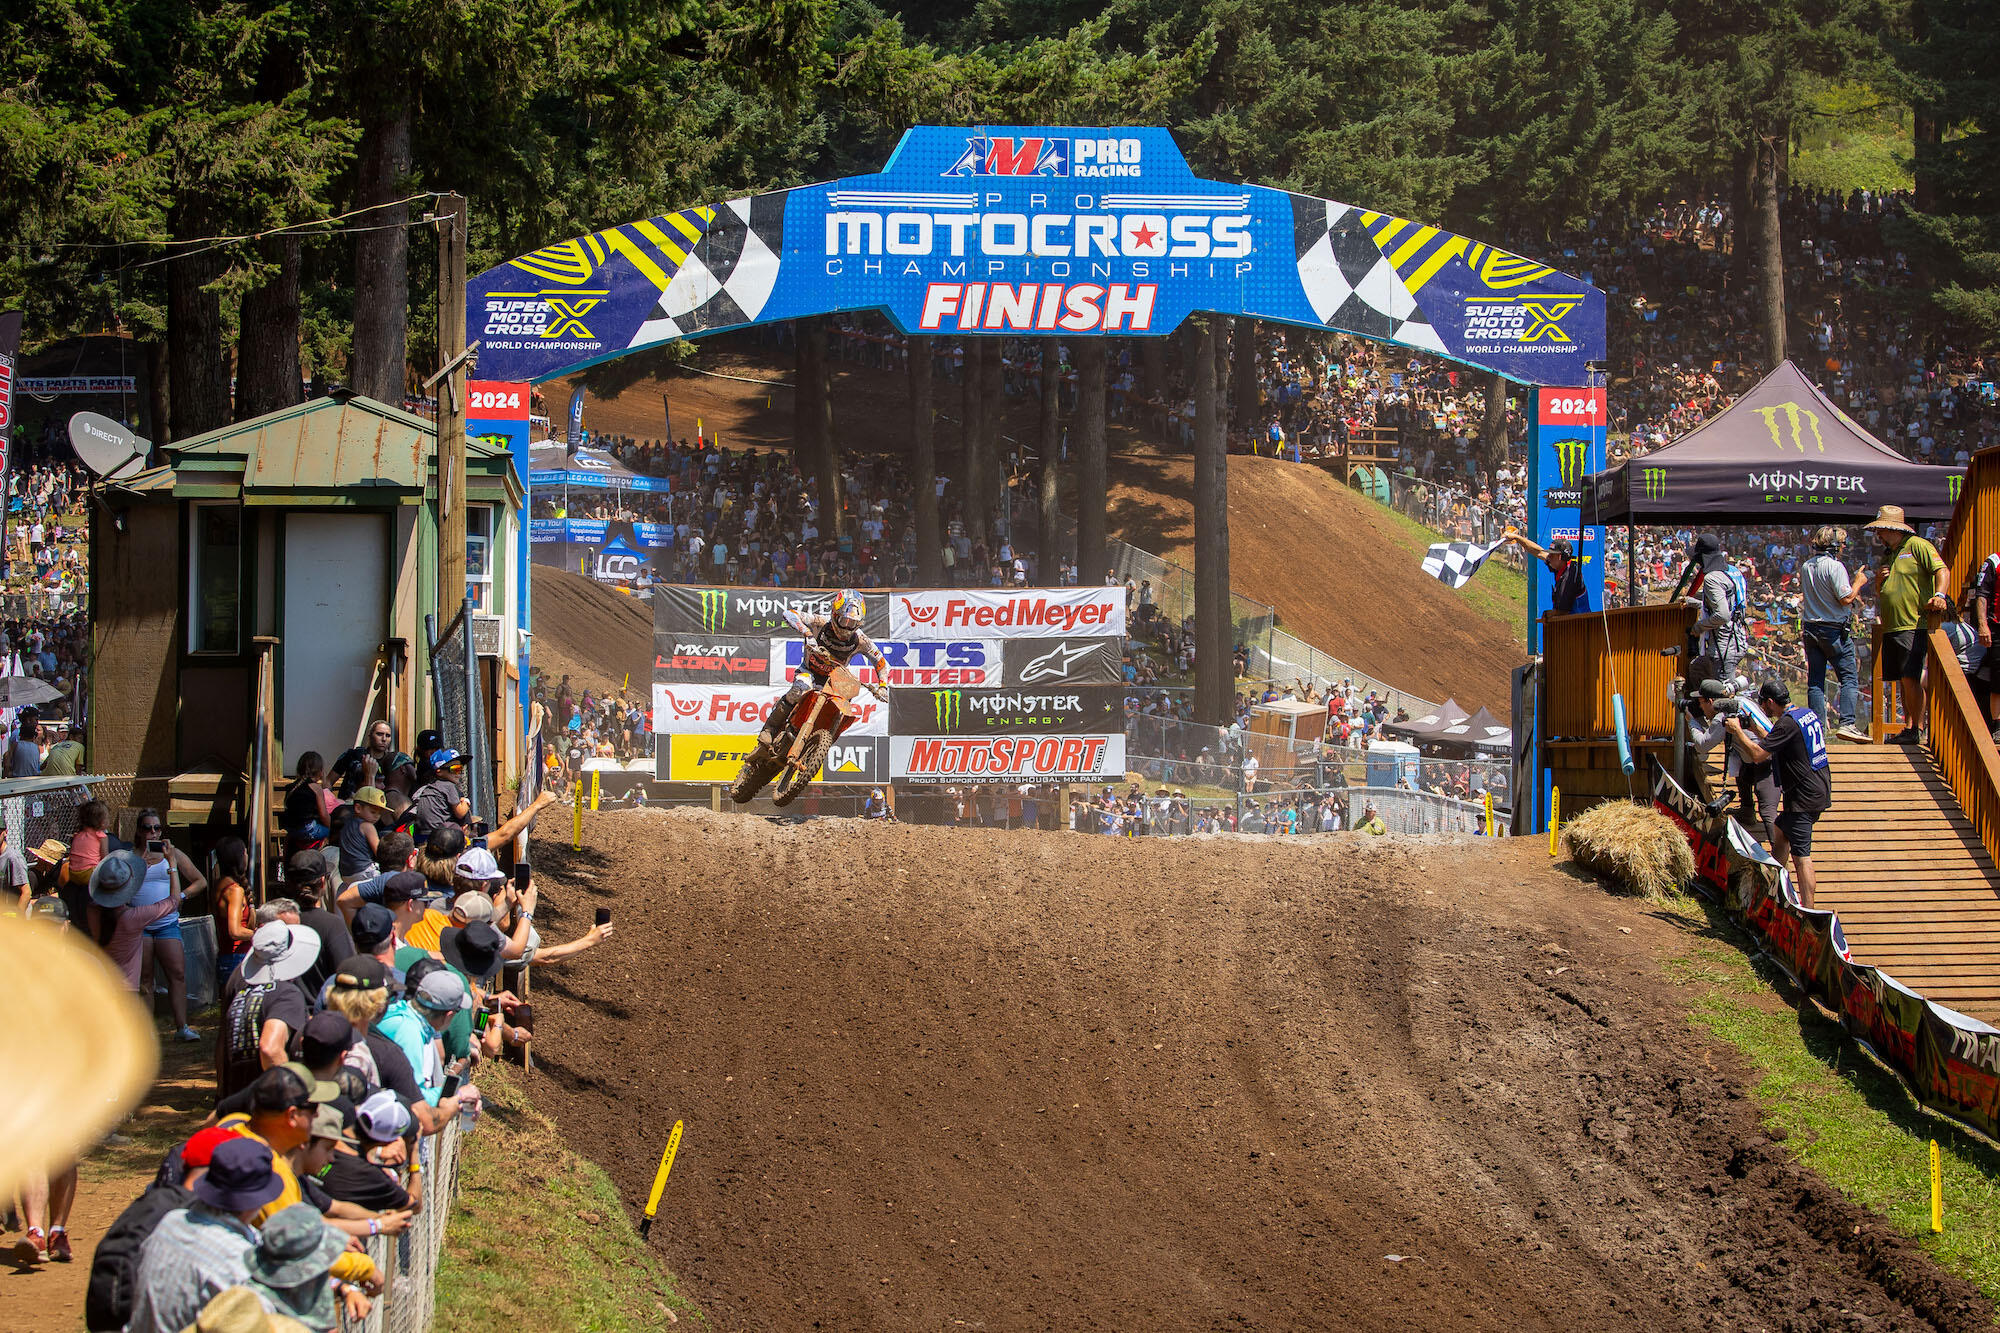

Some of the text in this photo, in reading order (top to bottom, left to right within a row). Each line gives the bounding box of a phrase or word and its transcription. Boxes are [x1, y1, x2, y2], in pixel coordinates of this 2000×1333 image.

[940, 137, 1142, 177] AMA PRO
[1074, 164, 1142, 178] RACING
[986, 192, 1094, 210] PRO
[825, 212, 1252, 258] MOTOCROSS
[826, 259, 1252, 279] CHAMPIONSHIP
[484, 301, 551, 313] SUPER
[919, 282, 1159, 332] FINISH
[1464, 306, 1528, 317] SUPER
[489, 312, 547, 324] MOTO
[1468, 317, 1525, 328] MOTO
[484, 324, 548, 335] CROSS
[1464, 328, 1526, 339] CROSS
[486, 341, 602, 350] WORLD CHAMPIONSHIP
[1466, 345, 1578, 354] WORLD CHAMPIONSHIP
[470, 391, 521, 409] 2024
[1550, 398, 1598, 415] 2024
[91, 426, 123, 445] DIRECTV
[601, 476, 632, 485] CUSTOM
[1748, 470, 1867, 493] MONSTER
[1548, 490, 1582, 499] MONST
[1765, 495, 1848, 504] ENERGY
[736, 595, 834, 616] MONSTE
[655, 655, 768, 675] LEGENDS
[969, 693, 1083, 714] MONSTER
[986, 717, 1065, 725] ENERGY
[828, 746, 871, 773] CAT
